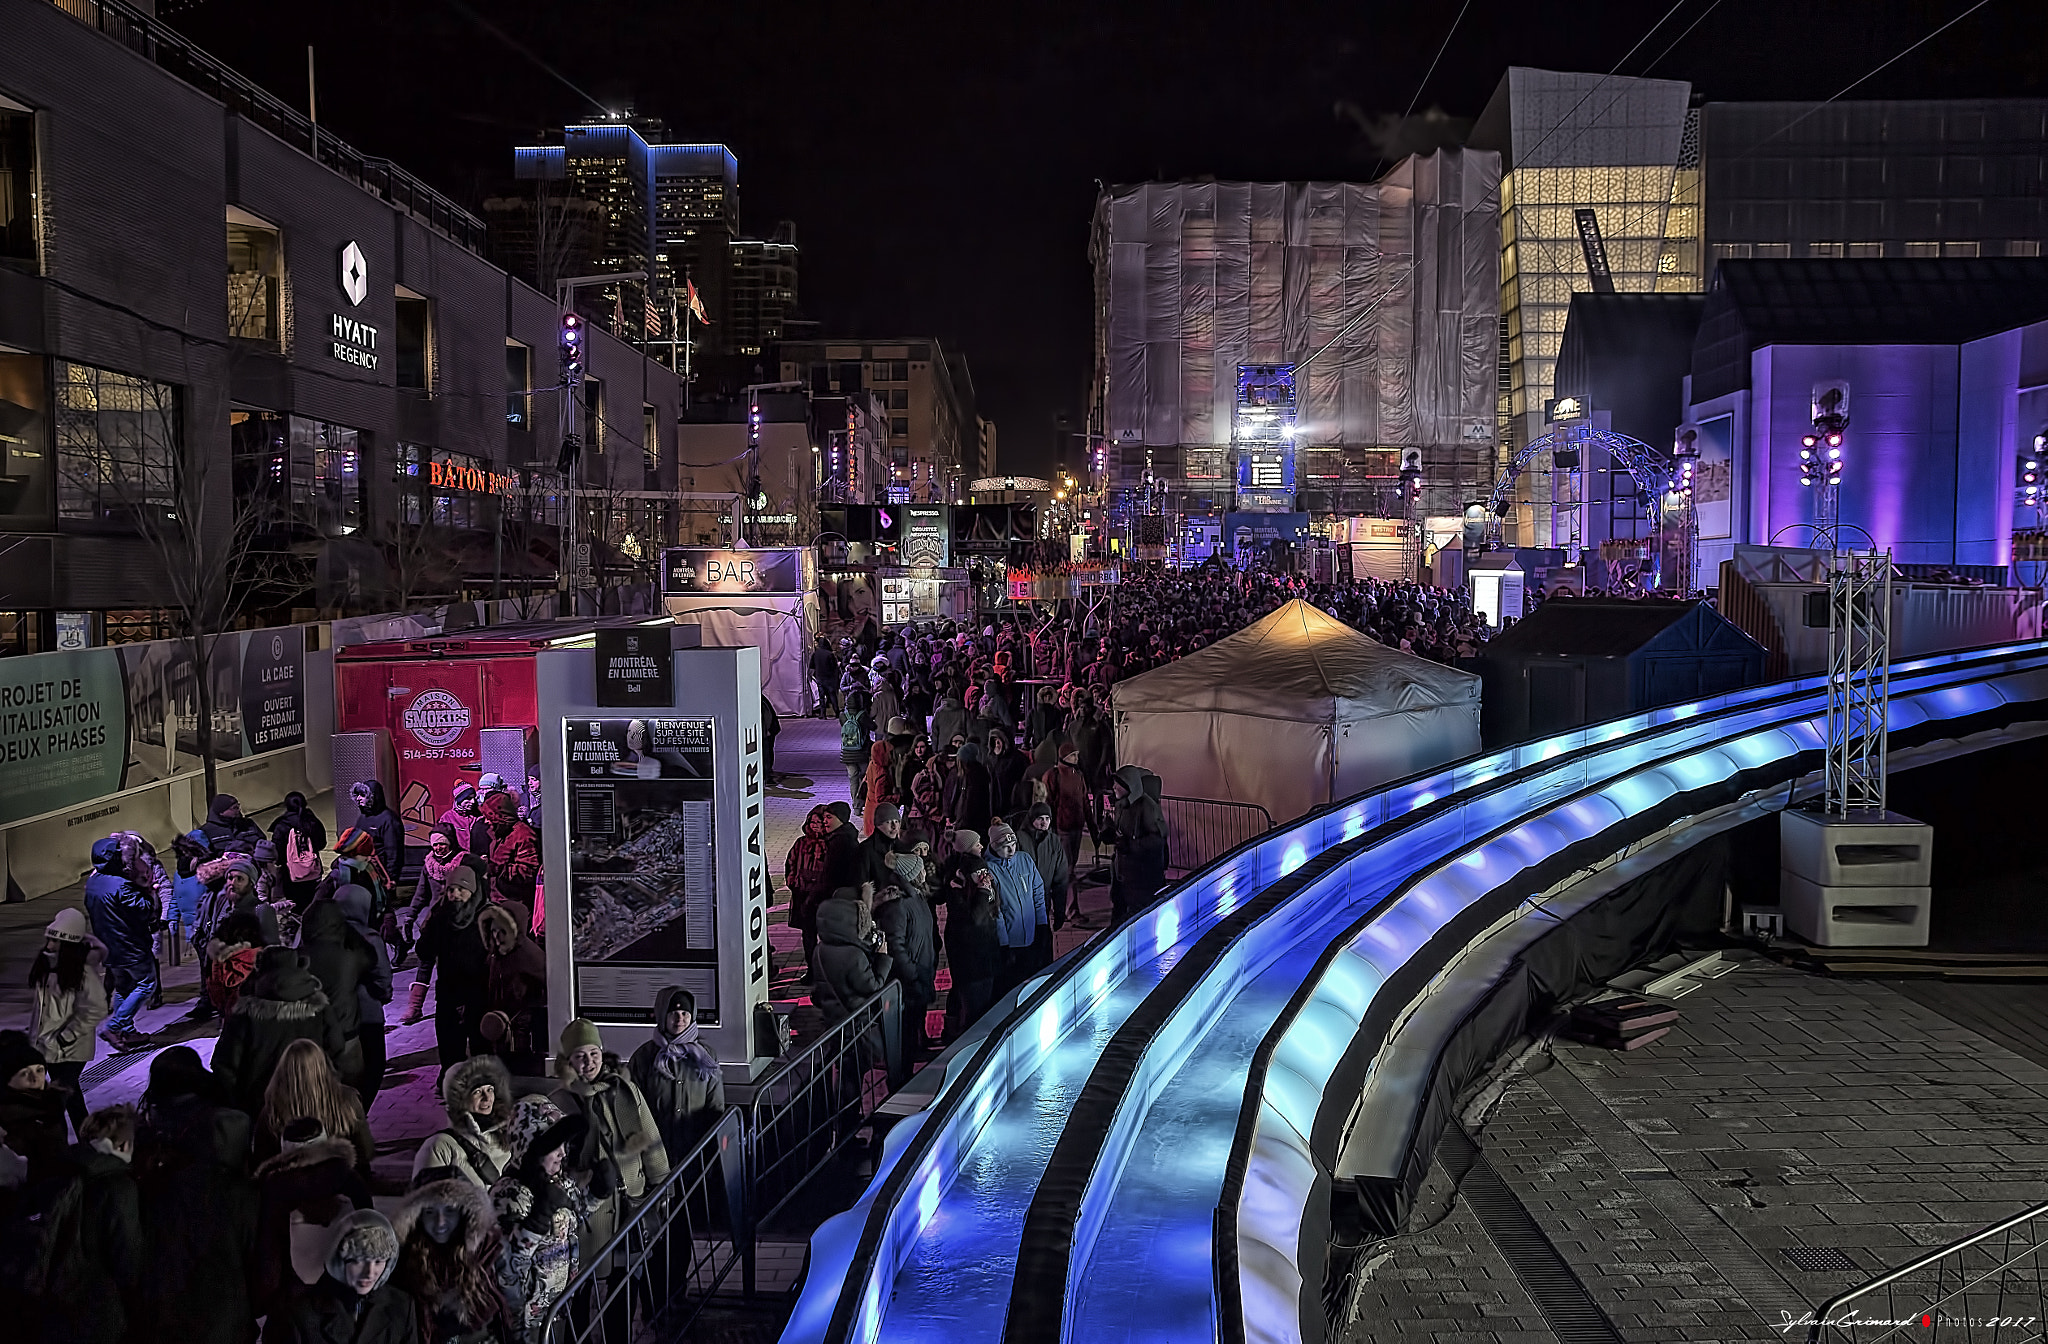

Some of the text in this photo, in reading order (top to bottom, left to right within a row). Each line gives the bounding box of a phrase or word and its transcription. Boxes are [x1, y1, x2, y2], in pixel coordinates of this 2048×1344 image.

[334, 313, 377, 349] HYATT
[334, 342, 377, 370] REGENCY
[430, 458, 485, 492] BÂTON
[707, 560, 755, 582] BAR
[609, 656, 657, 668] MONTRÉAL
[261, 665, 294, 682] LA CAGE
[608, 667, 660, 679] EN LUMIÈRE
[61, 679, 81, 700] DE
[264, 696, 293, 712] OUVERT
[417, 693, 455, 707] MAISON
[261, 710, 296, 728] PENDANT
[404, 709, 470, 729] SMOKIES
[656, 721, 705, 729] BIENVENUE
[48, 726, 106, 755] PHASES
[255, 723, 302, 744] LES TRAVAUX
[653, 737, 665, 745] DU
[667, 737, 705, 745] FESTIVAL
[404, 749, 475, 759] 514-557-3866
[574, 740, 618, 751] MONTRÉAL
[572, 750, 621, 761] EN LUMIÈRE
[745, 723, 764, 985] HORAIRE
